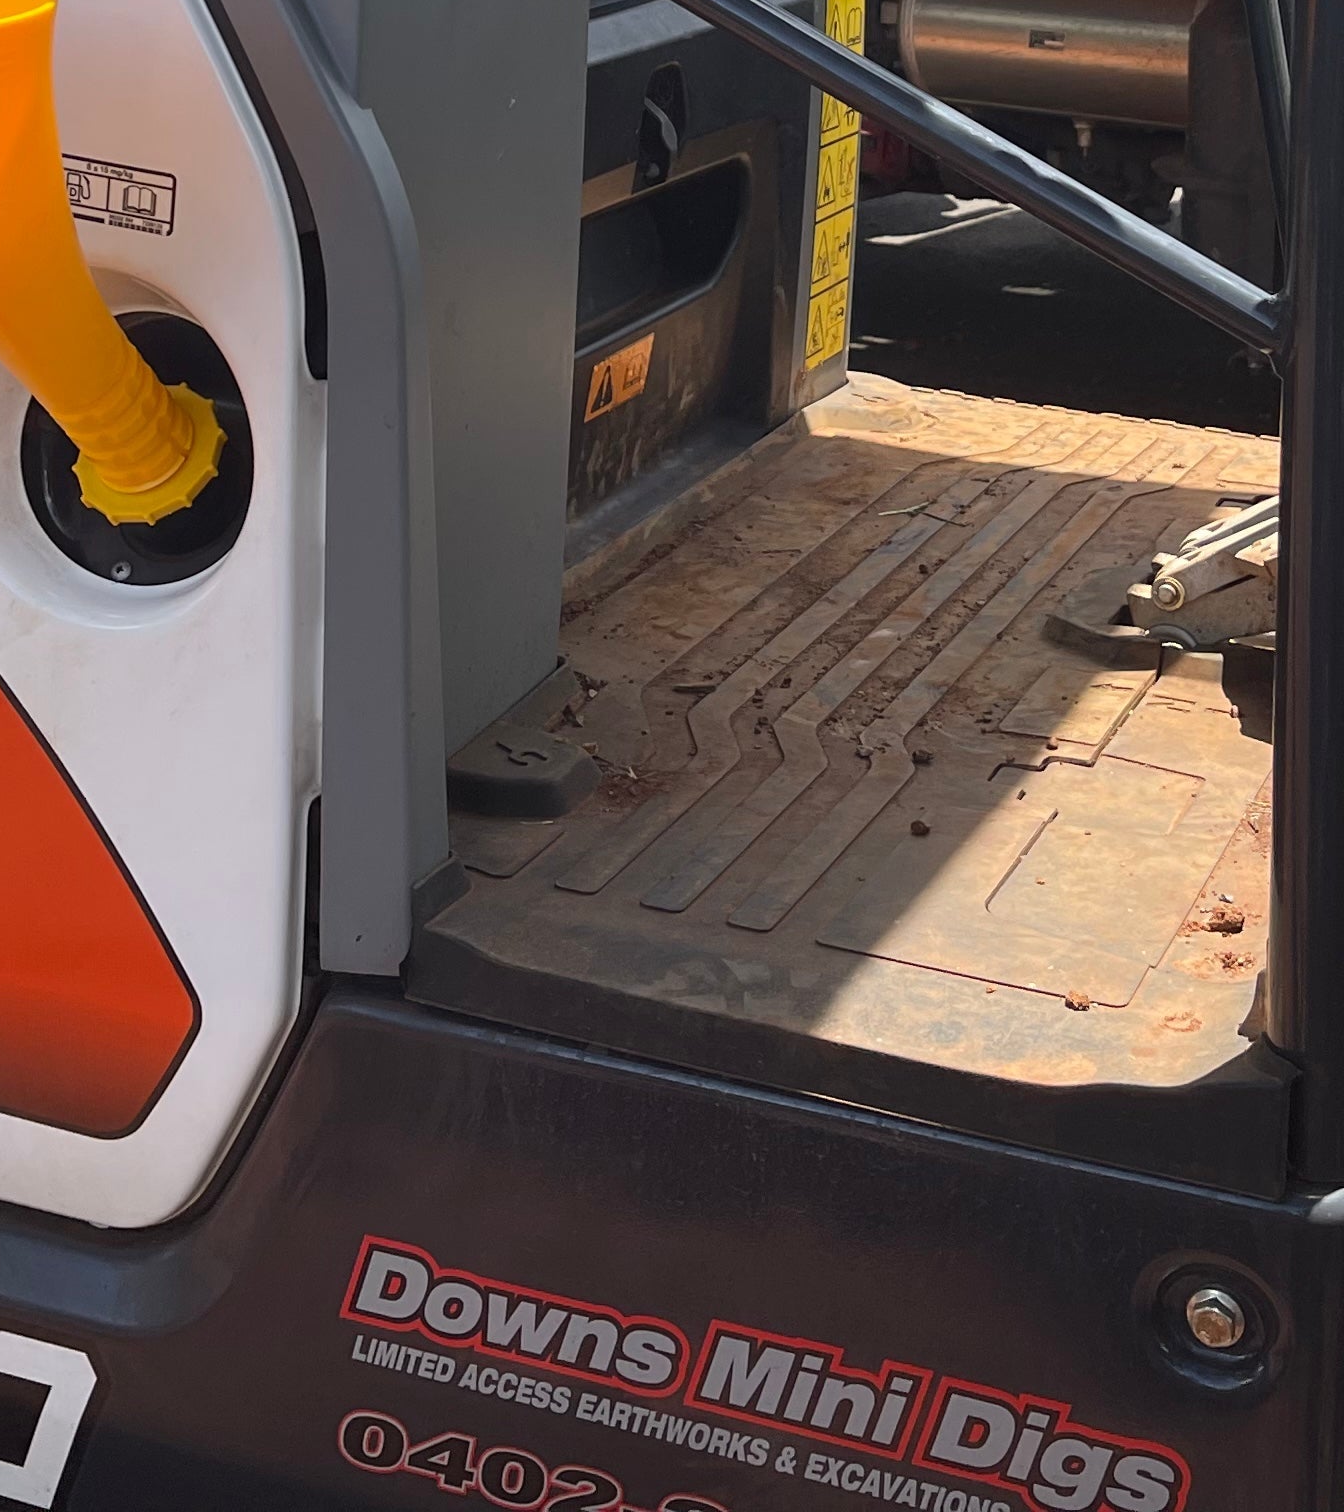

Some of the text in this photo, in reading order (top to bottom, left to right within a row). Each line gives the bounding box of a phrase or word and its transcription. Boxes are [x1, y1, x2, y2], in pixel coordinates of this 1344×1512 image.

[351, 1334, 457, 1384] LIMITED
[458, 1363, 572, 1415] ACCESS
[575, 1392, 771, 1467] EARTHWORKS
[774, 1445, 797, 1476] &
[355, 1249, 1177, 1512] Downs Mini Digs
